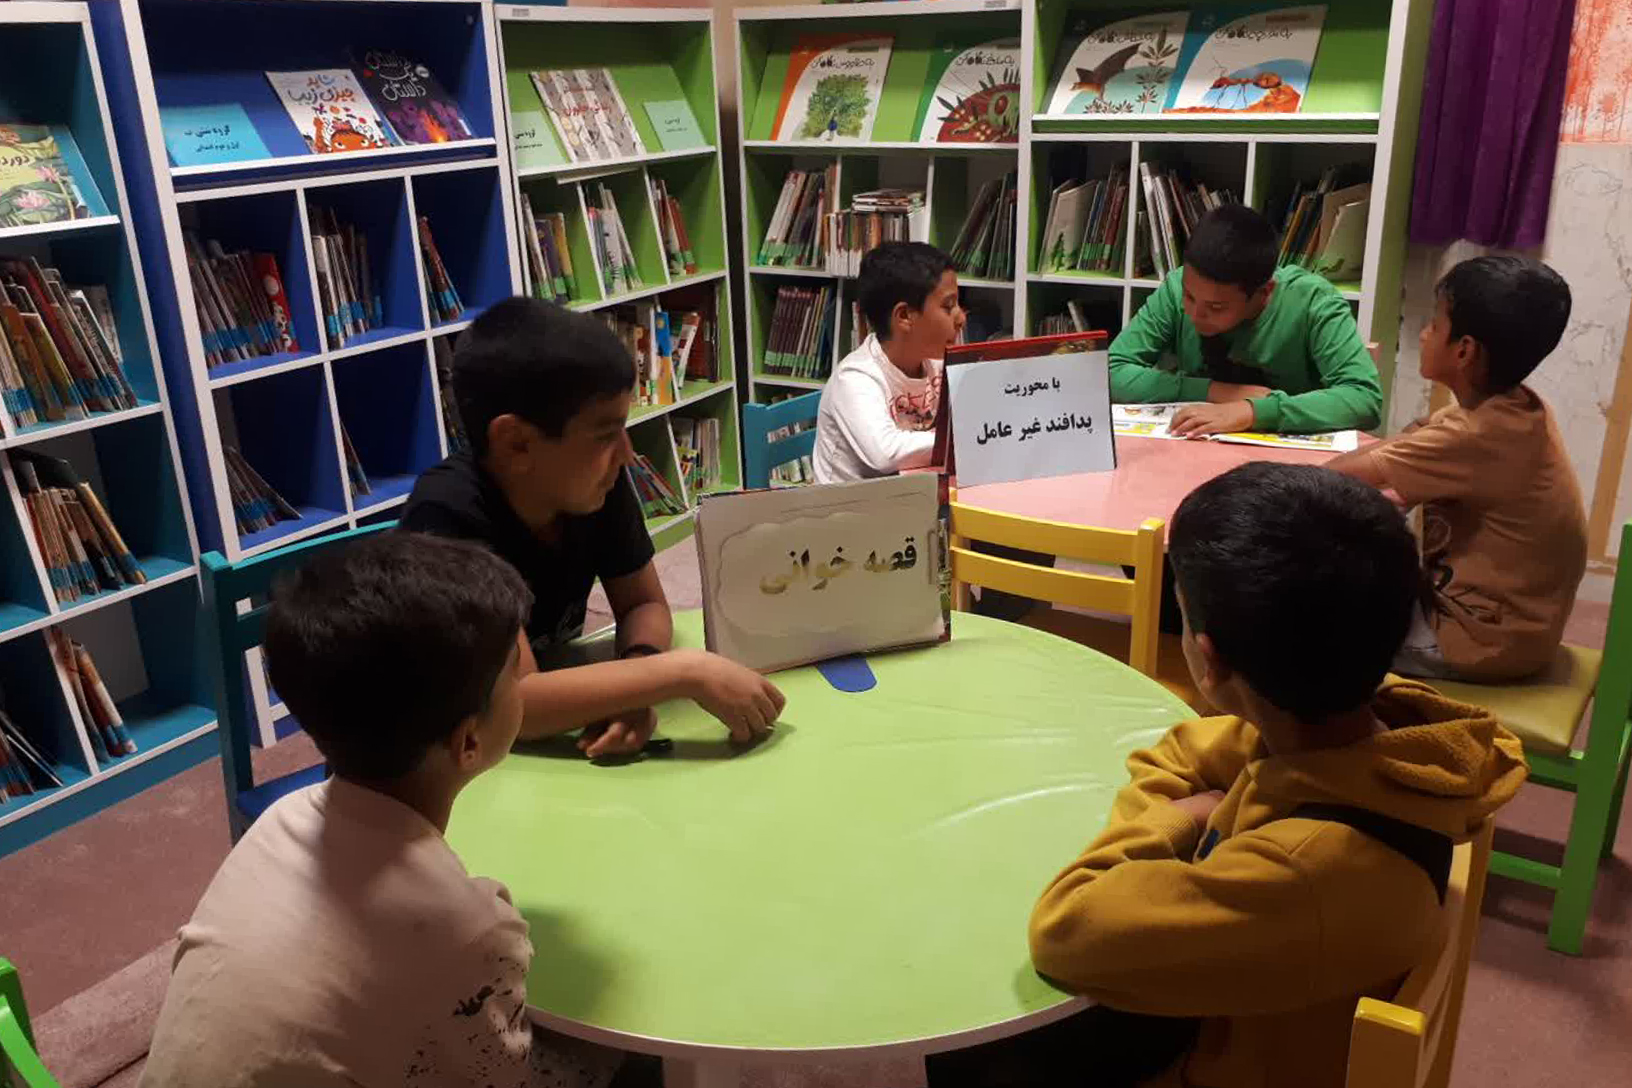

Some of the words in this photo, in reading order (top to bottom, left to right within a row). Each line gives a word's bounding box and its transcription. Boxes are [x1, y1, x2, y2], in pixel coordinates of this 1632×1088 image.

[287, 88, 319, 105] زیبا
[1004, 380, 1049, 397] محوریت
[1051, 377, 1061, 393] با
[976, 421, 1012, 445] عامل
[1018, 417, 1042, 441] غیر
[1046, 412, 1092, 434] پدافند
[863, 536, 918, 574] قصه
[759, 546, 854, 595] خوانی
